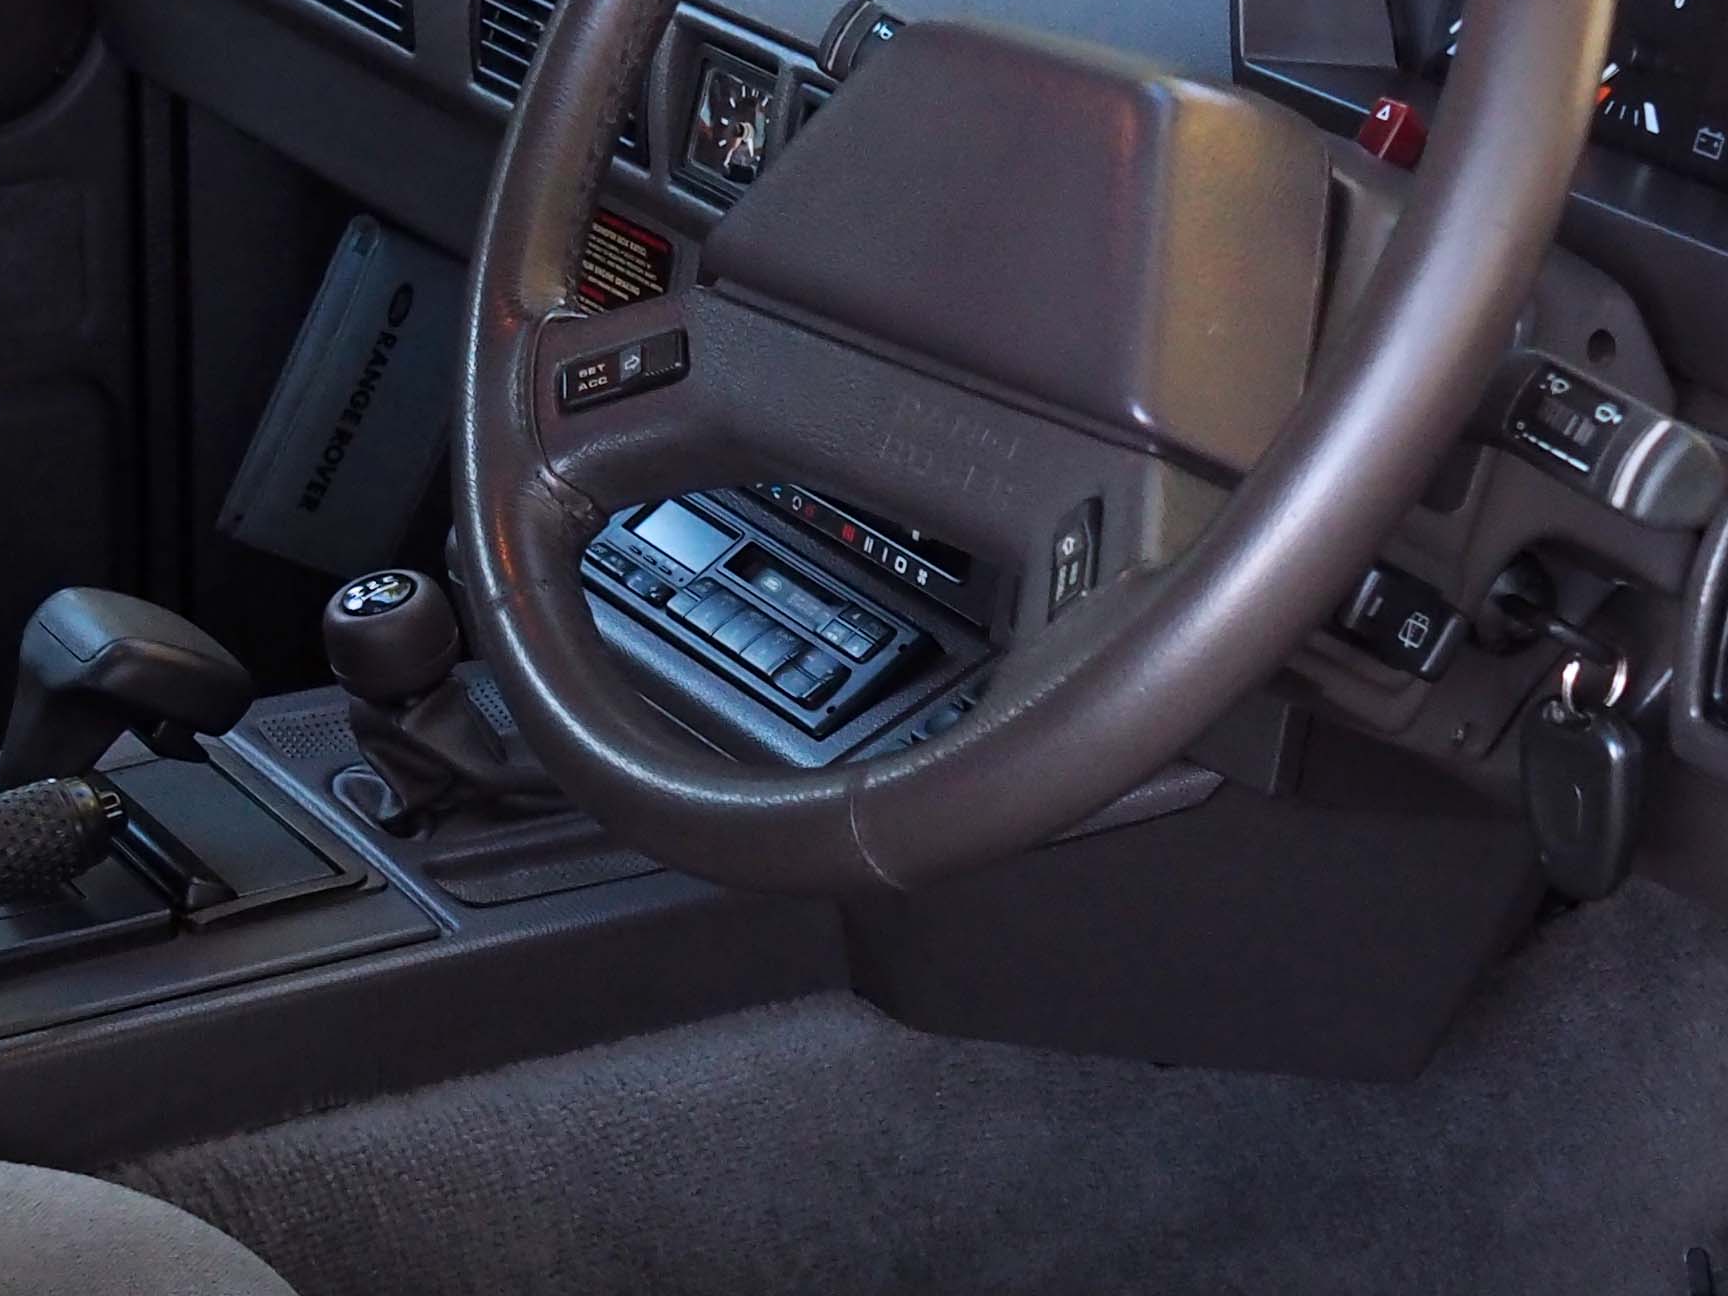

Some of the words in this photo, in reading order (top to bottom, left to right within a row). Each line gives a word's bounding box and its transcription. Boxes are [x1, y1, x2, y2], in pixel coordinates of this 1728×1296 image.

[346, 331, 398, 427] RANGE
[577, 376, 608, 392] ACC
[299, 427, 354, 513] ROVER
